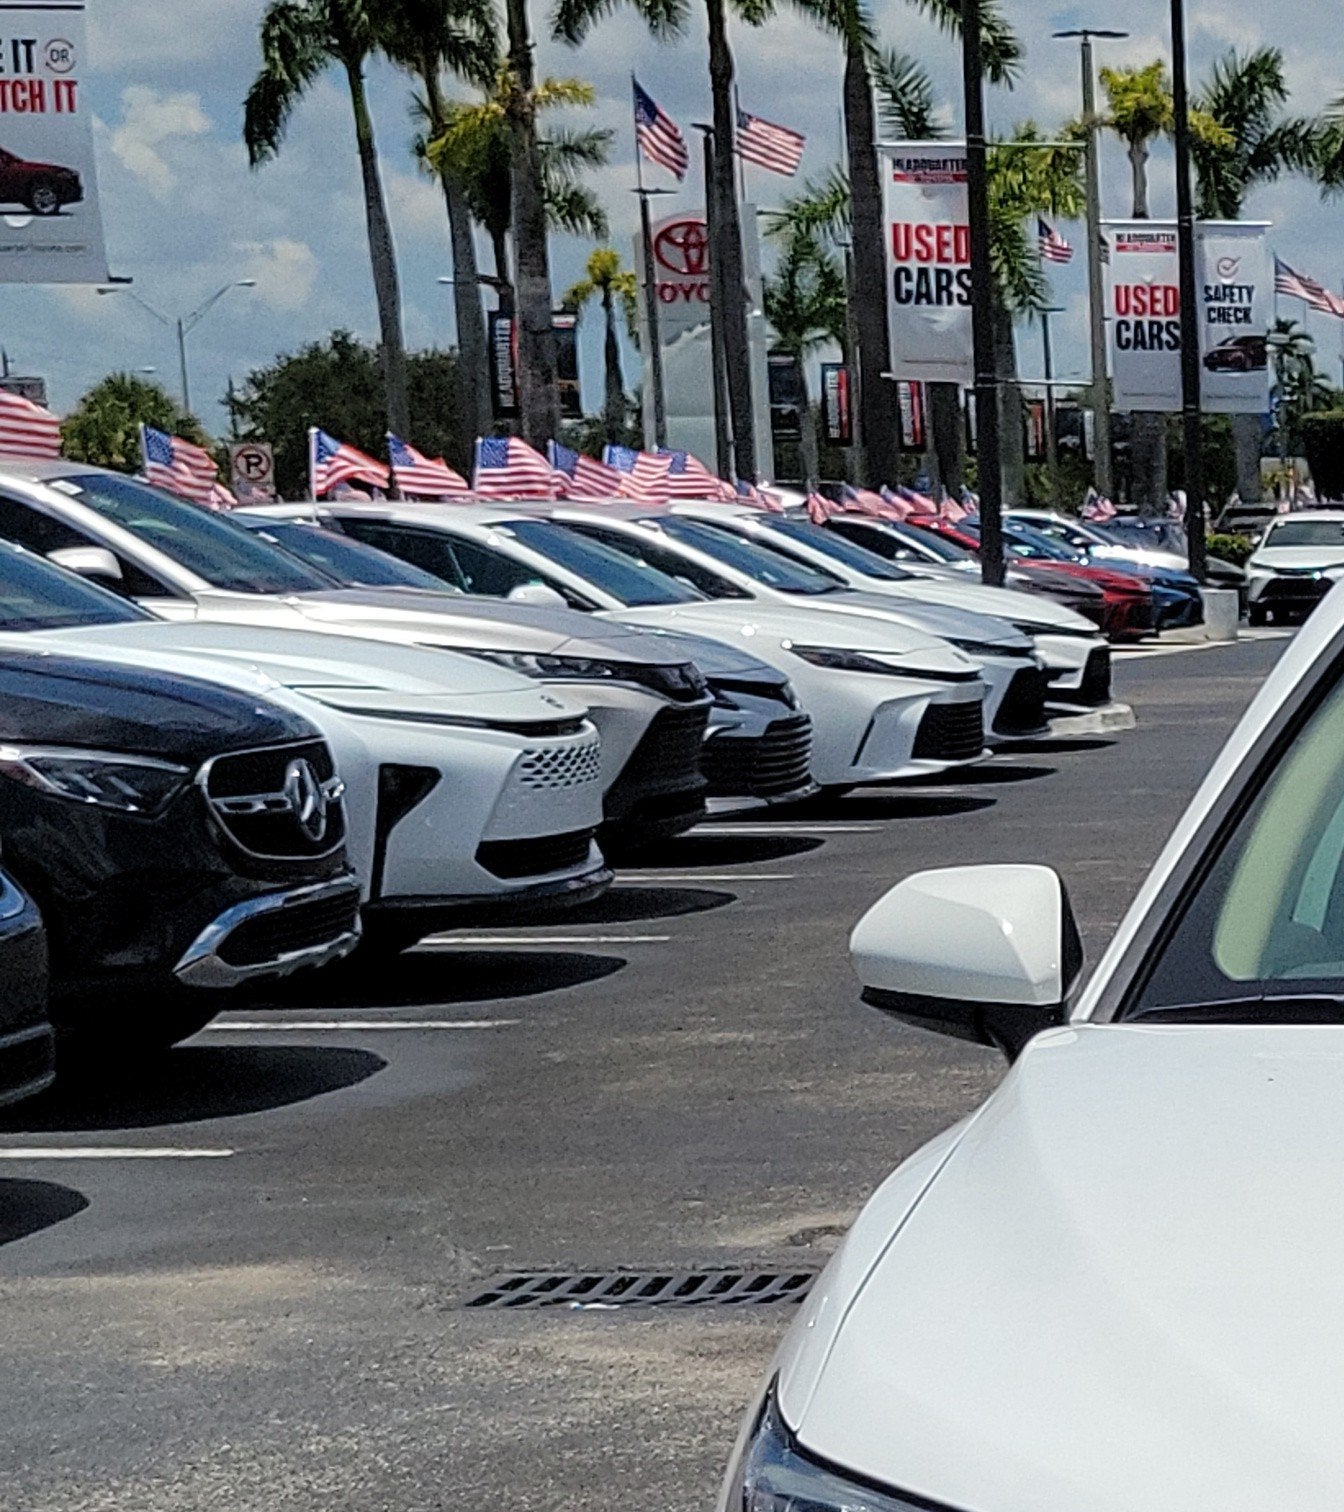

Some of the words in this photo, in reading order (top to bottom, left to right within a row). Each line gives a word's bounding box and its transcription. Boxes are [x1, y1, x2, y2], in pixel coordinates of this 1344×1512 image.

[11, 38, 37, 74] IT
[53, 79, 78, 113] IT
[892, 222, 971, 264] USED
[893, 265, 973, 306] CARS
[1114, 284, 1179, 317] USED
[1203, 284, 1255, 304] SAFETY
[1206, 306, 1253, 324] CHECK
[1115, 319, 1181, 351] CARS
